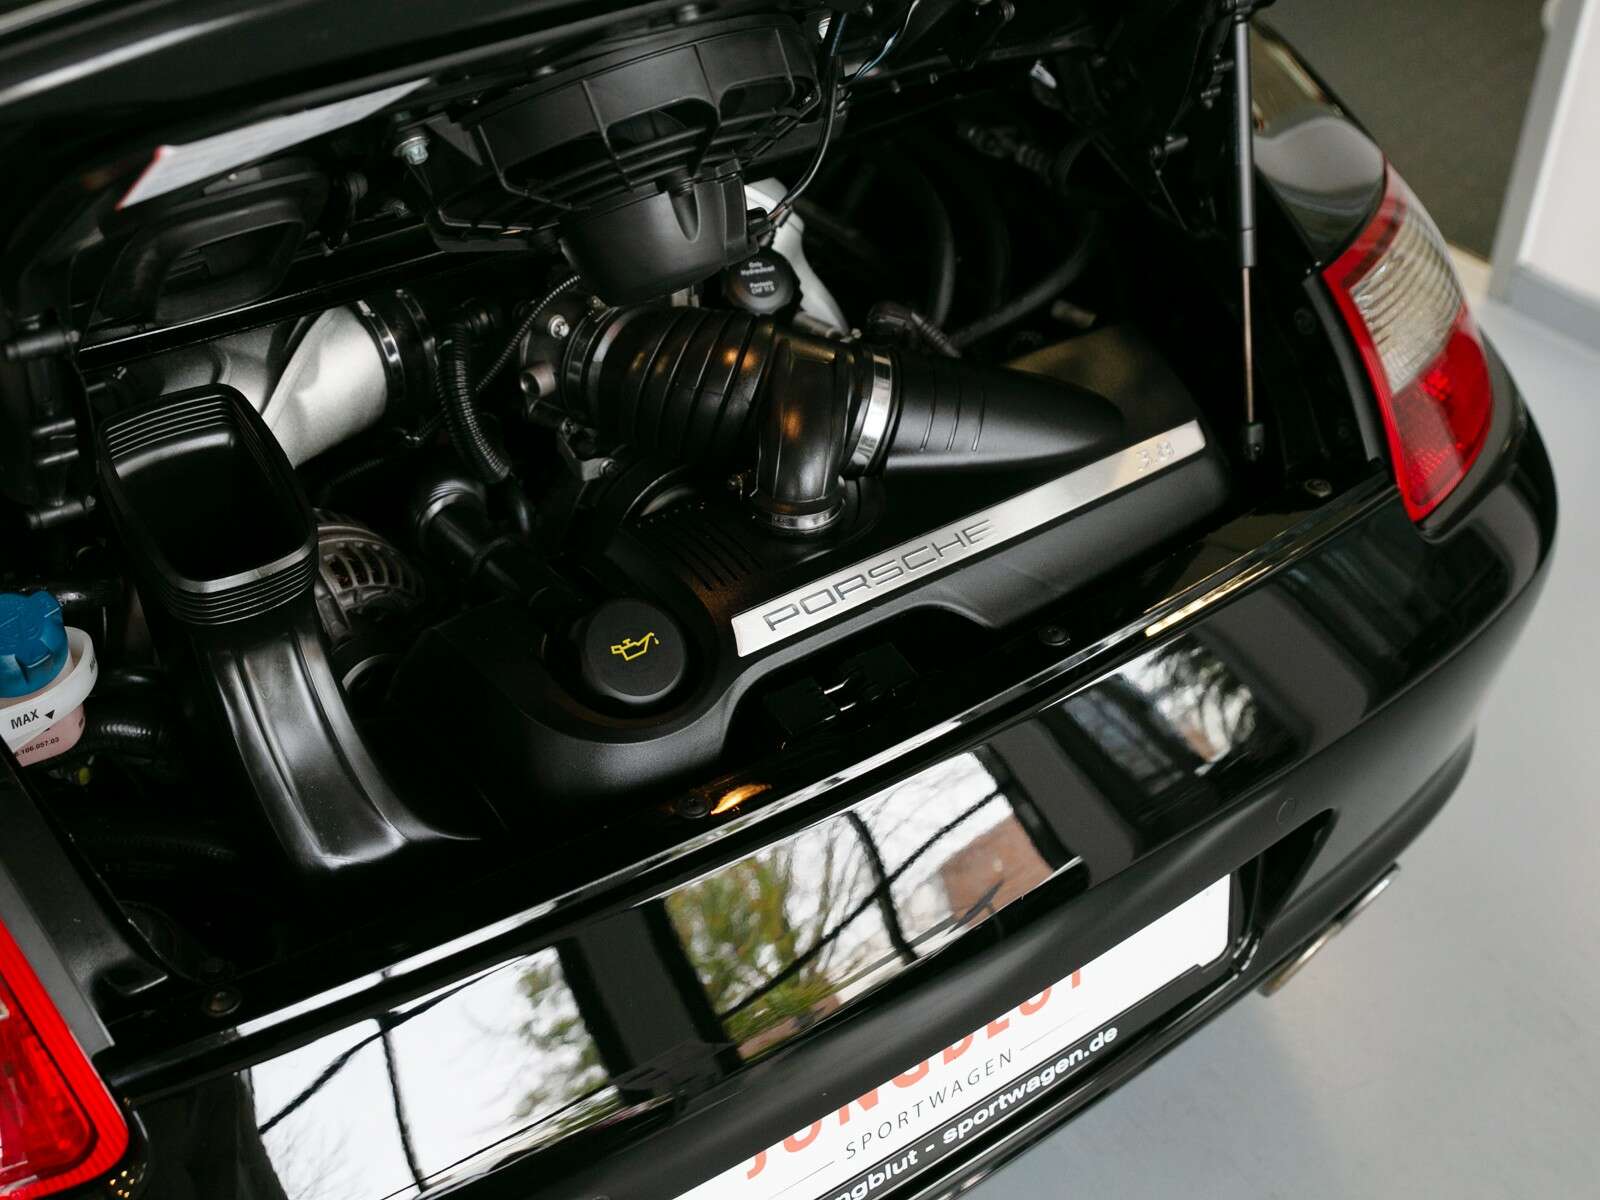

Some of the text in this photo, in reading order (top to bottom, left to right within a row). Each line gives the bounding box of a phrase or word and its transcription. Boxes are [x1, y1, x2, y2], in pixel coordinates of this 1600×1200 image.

[763, 520, 993, 632] PORSCHE
[10, 709, 40, 730] MAX
[847, 1048, 1012, 1159] SPORTWAGEN
[943, 1024, 1118, 1145] sportwagen.de
